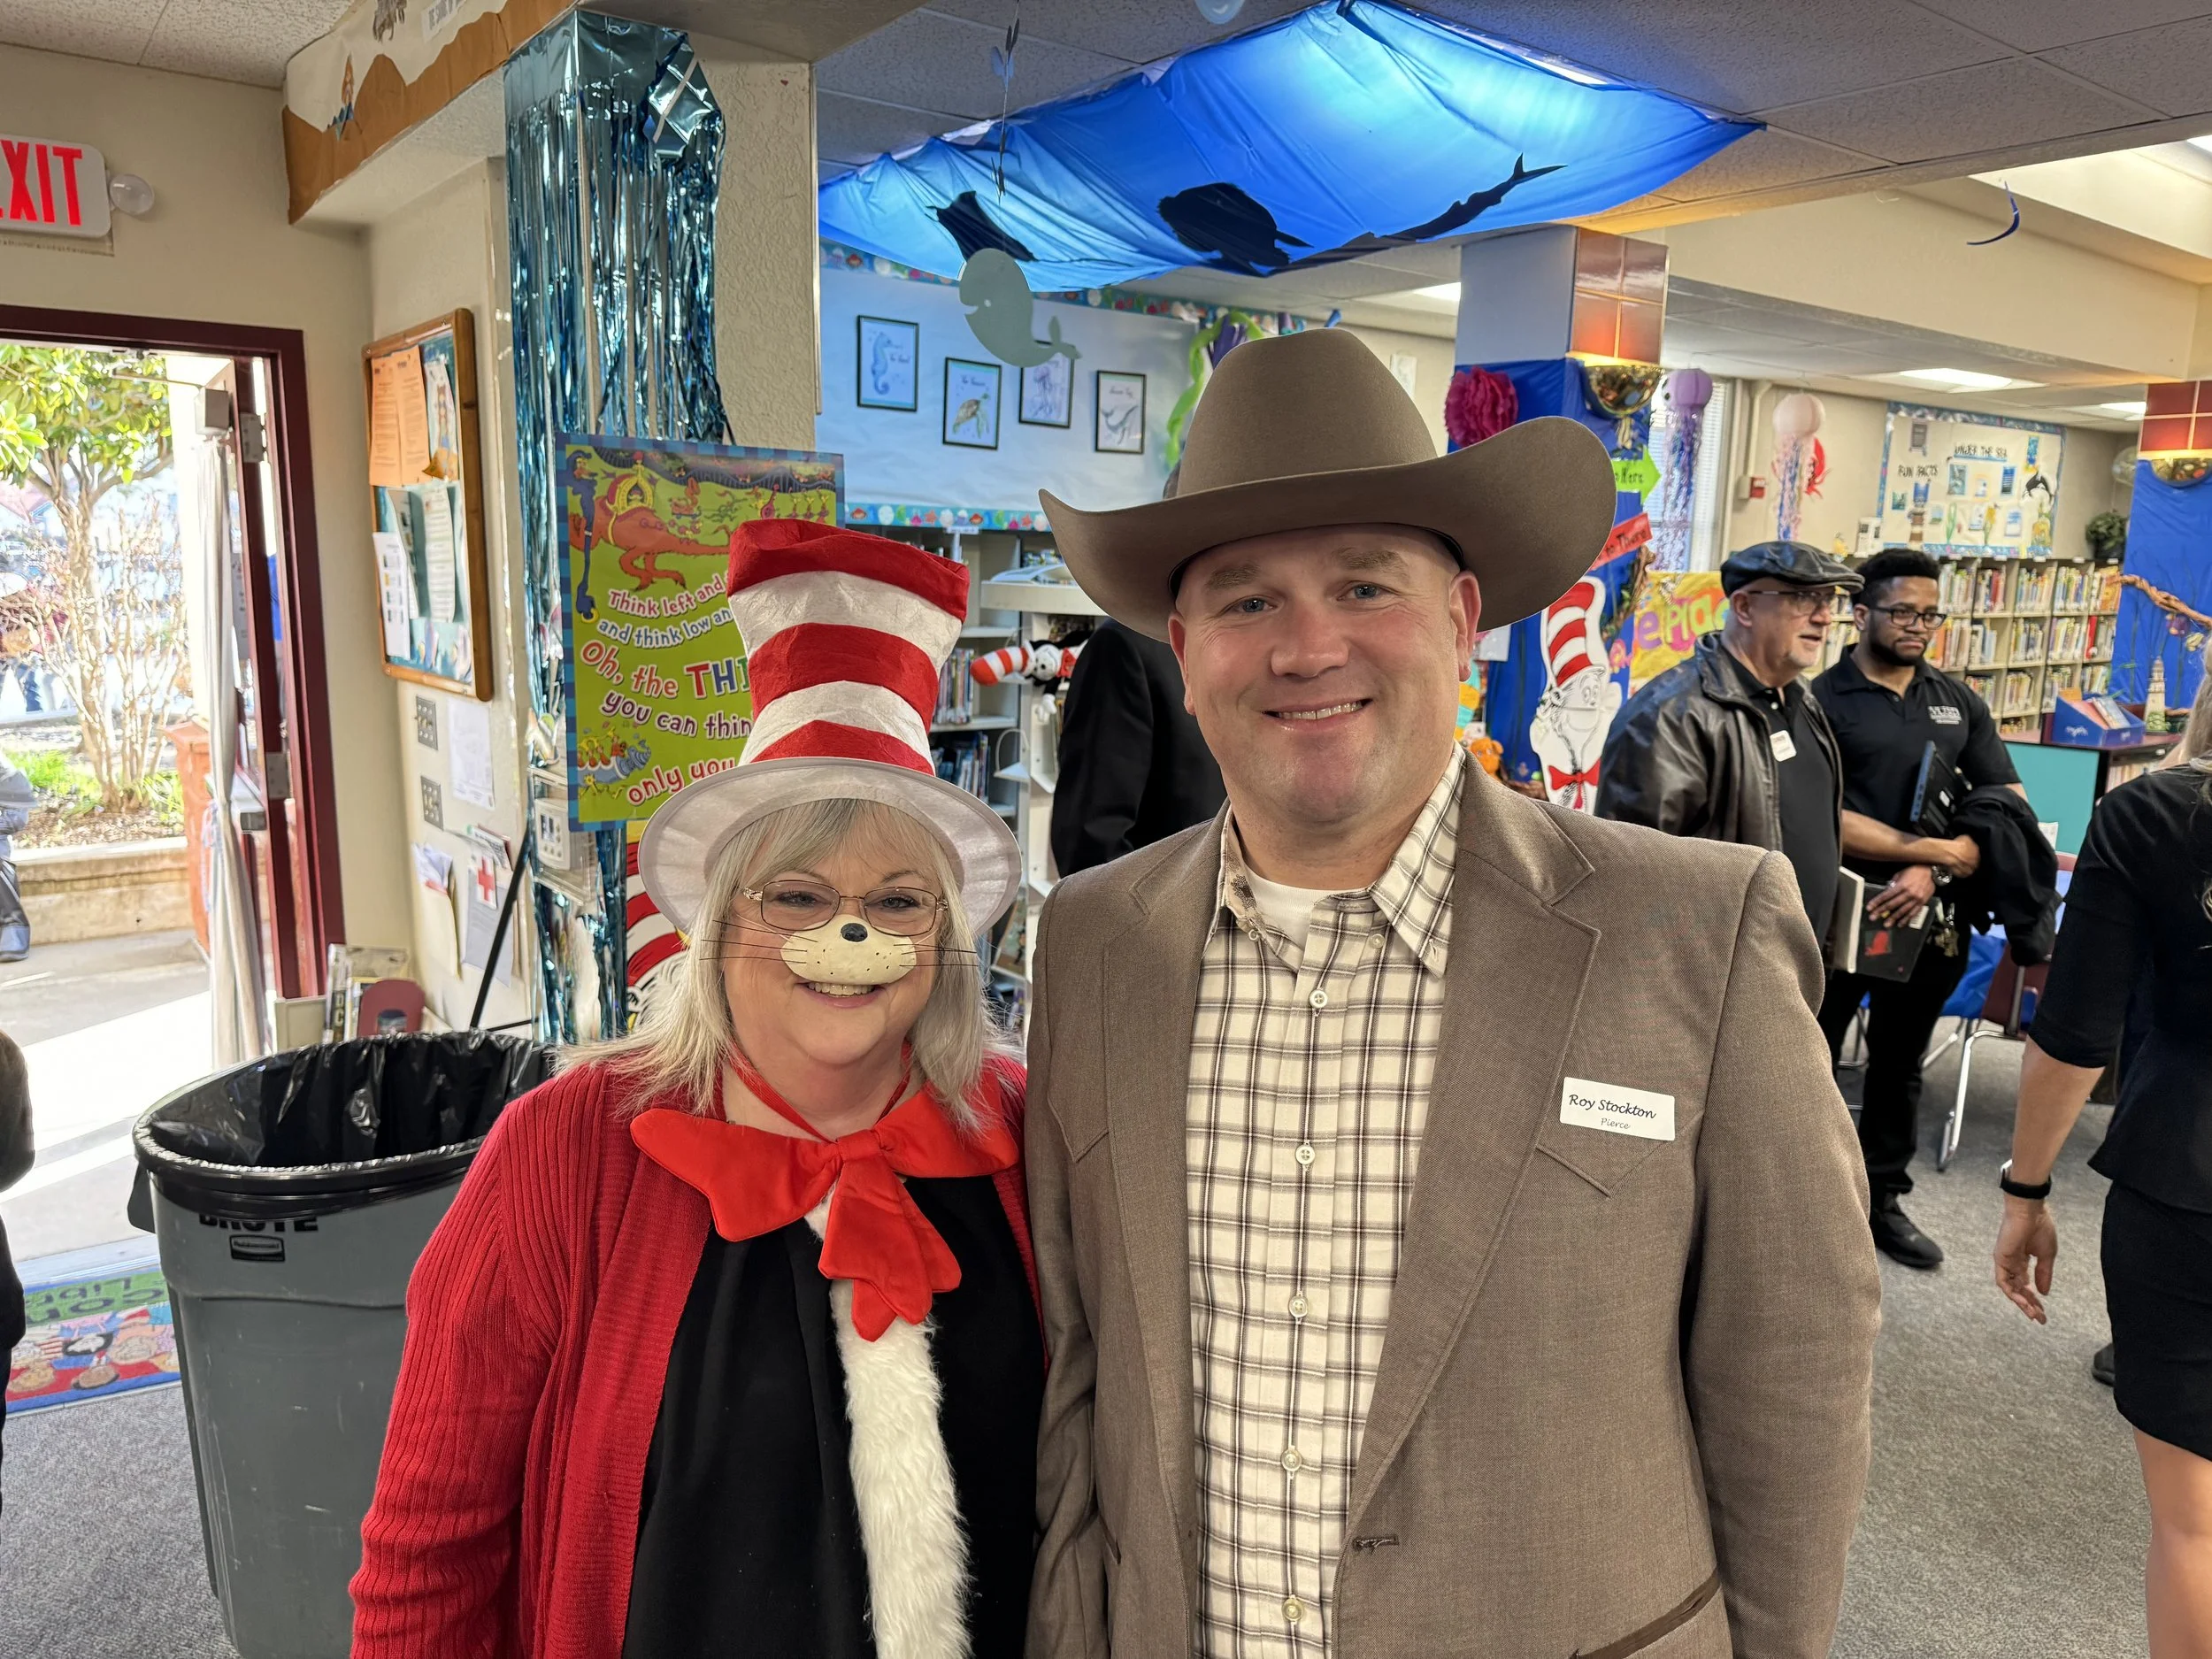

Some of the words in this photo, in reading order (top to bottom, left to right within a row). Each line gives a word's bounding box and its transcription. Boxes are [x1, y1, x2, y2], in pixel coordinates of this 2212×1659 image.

[0, 138, 82, 227] XIT
[609, 588, 658, 617] Think
[661, 593, 695, 615] left
[696, 575, 724, 600] and
[600, 619, 632, 642] and
[635, 626, 682, 646] think
[682, 618, 711, 637] low
[712, 609, 733, 624] an
[581, 641, 624, 682] Oh,
[632, 664, 679, 696] the
[601, 692, 651, 722] you
[657, 713, 697, 736] can
[628, 766, 685, 803] only
[1569, 1094, 1595, 1110] Roy
[1597, 1099, 1657, 1119] Stockton
[1601, 1118, 1631, 1129] Pierce
